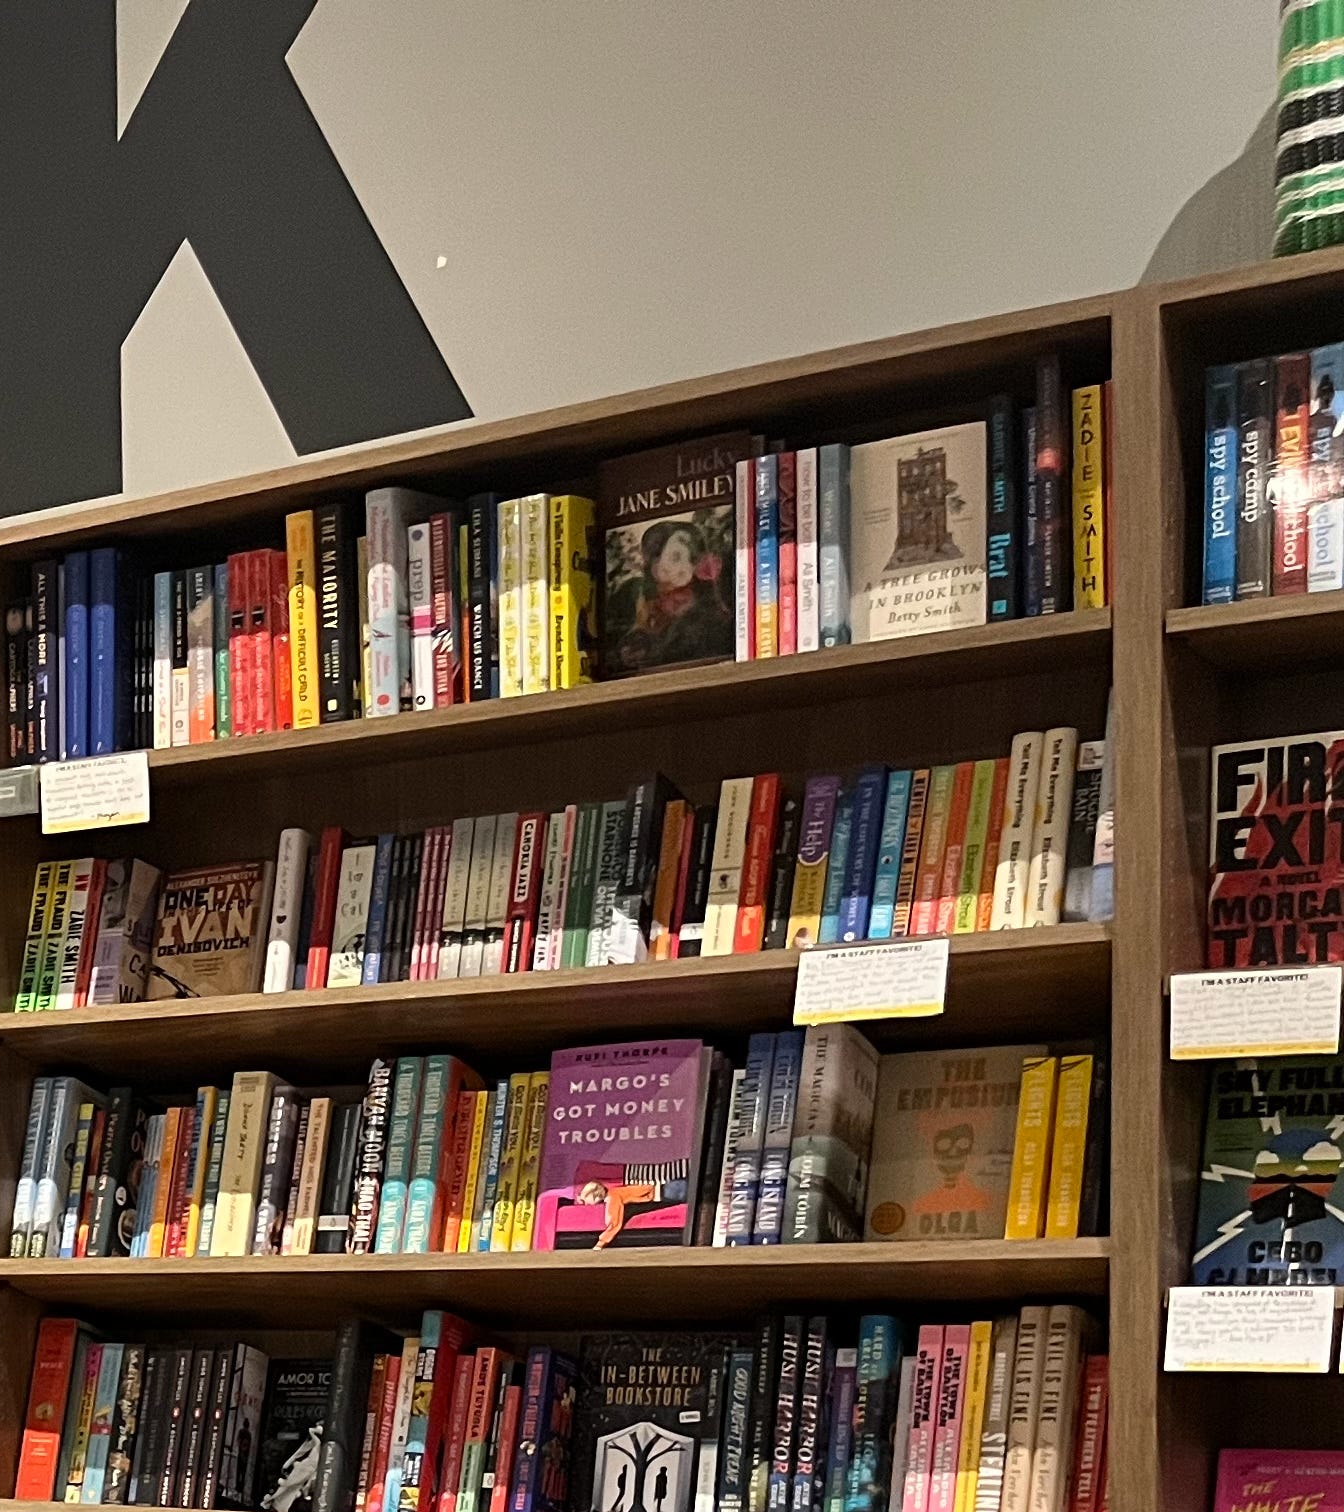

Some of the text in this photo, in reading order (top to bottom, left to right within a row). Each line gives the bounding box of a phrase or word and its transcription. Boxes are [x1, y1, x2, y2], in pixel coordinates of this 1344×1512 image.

[1081, 394, 1094, 482] ZADIE
[1210, 436, 1230, 538] spy school
[1240, 431, 1258, 522] spy camp
[617, 475, 734, 516] JANE SMILEY
[989, 533, 1010, 580] Brat
[320, 516, 338, 630] THE MAJORITY
[410, 557, 423, 603] prep
[863, 563, 986, 593] A TREE GROWS
[868, 582, 982, 610] IN BROOKLYN
[887, 603, 962, 624] Betty Smith
[1216, 741, 1344, 812] FIR
[516, 822, 534, 898] CAHOKIA JAZZ
[163, 887, 203, 920] ONE
[1212, 888, 1344, 925] MORGA
[160, 904, 253, 946] IVAN
[61, 909, 85, 984] ZADIE SMITH
[157, 936, 250, 957] DENISOVICH
[852, 949, 875, 958] STAFF
[876, 946, 923, 956] FAVORITE!
[1213, 922, 1344, 966] TALT
[1225, 975, 1256, 985] STAFF
[1257, 974, 1309, 984] FAVORITE!
[575, 1047, 669, 1061] RUFI THORPE
[569, 1073, 671, 1094] MARGO'S
[942, 1059, 987, 1082] THE
[553, 1099, 685, 1121] GOT MONEY
[558, 1125, 673, 1144] TROUBLES
[918, 1212, 980, 1237] OLGA
[642, 1349, 662, 1363] THE
[277, 1372, 314, 1385] AMOR
[480, 1356, 491, 1394] AMOS
[600, 1366, 701, 1385] IN-BETWEEN
[1011, 1322, 1036, 1423] DEVIL IS FINE
[1041, 1322, 1066, 1422] DEVIL IS FINE
[606, 1388, 691, 1407] BOOKSTORE
[1242, 1481, 1276, 1497] THE
